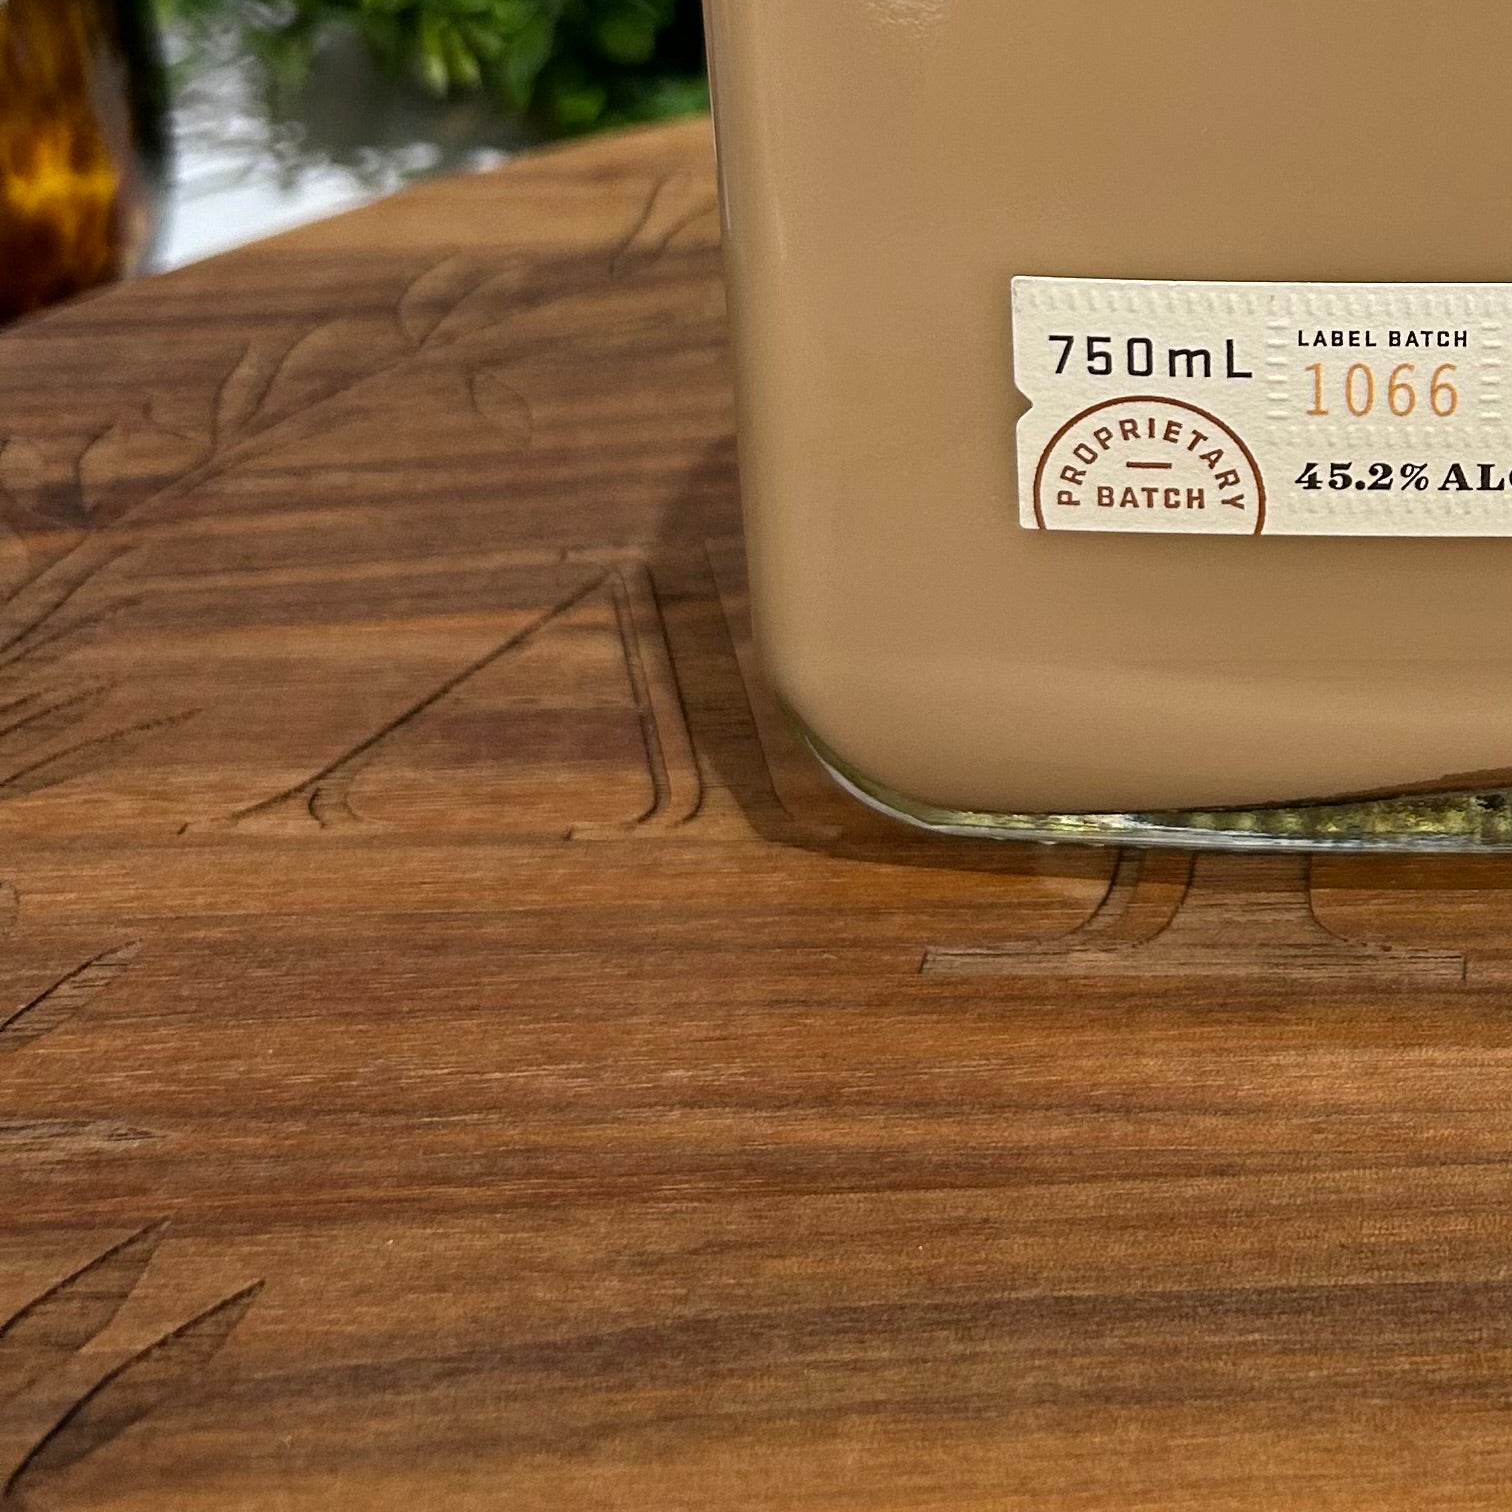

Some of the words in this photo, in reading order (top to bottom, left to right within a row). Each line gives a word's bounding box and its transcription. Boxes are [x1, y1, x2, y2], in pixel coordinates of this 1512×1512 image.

[1048, 335, 1253, 379] 750mL
[1298, 329, 1377, 347] LABEL
[1388, 330, 1467, 348] BATCH
[1306, 363, 1458, 417] 1066
[1057, 416, 1246, 510] PROPRIETARY
[1294, 461, 1429, 491] 45.2%
[1096, 485, 1205, 510] BATCH
